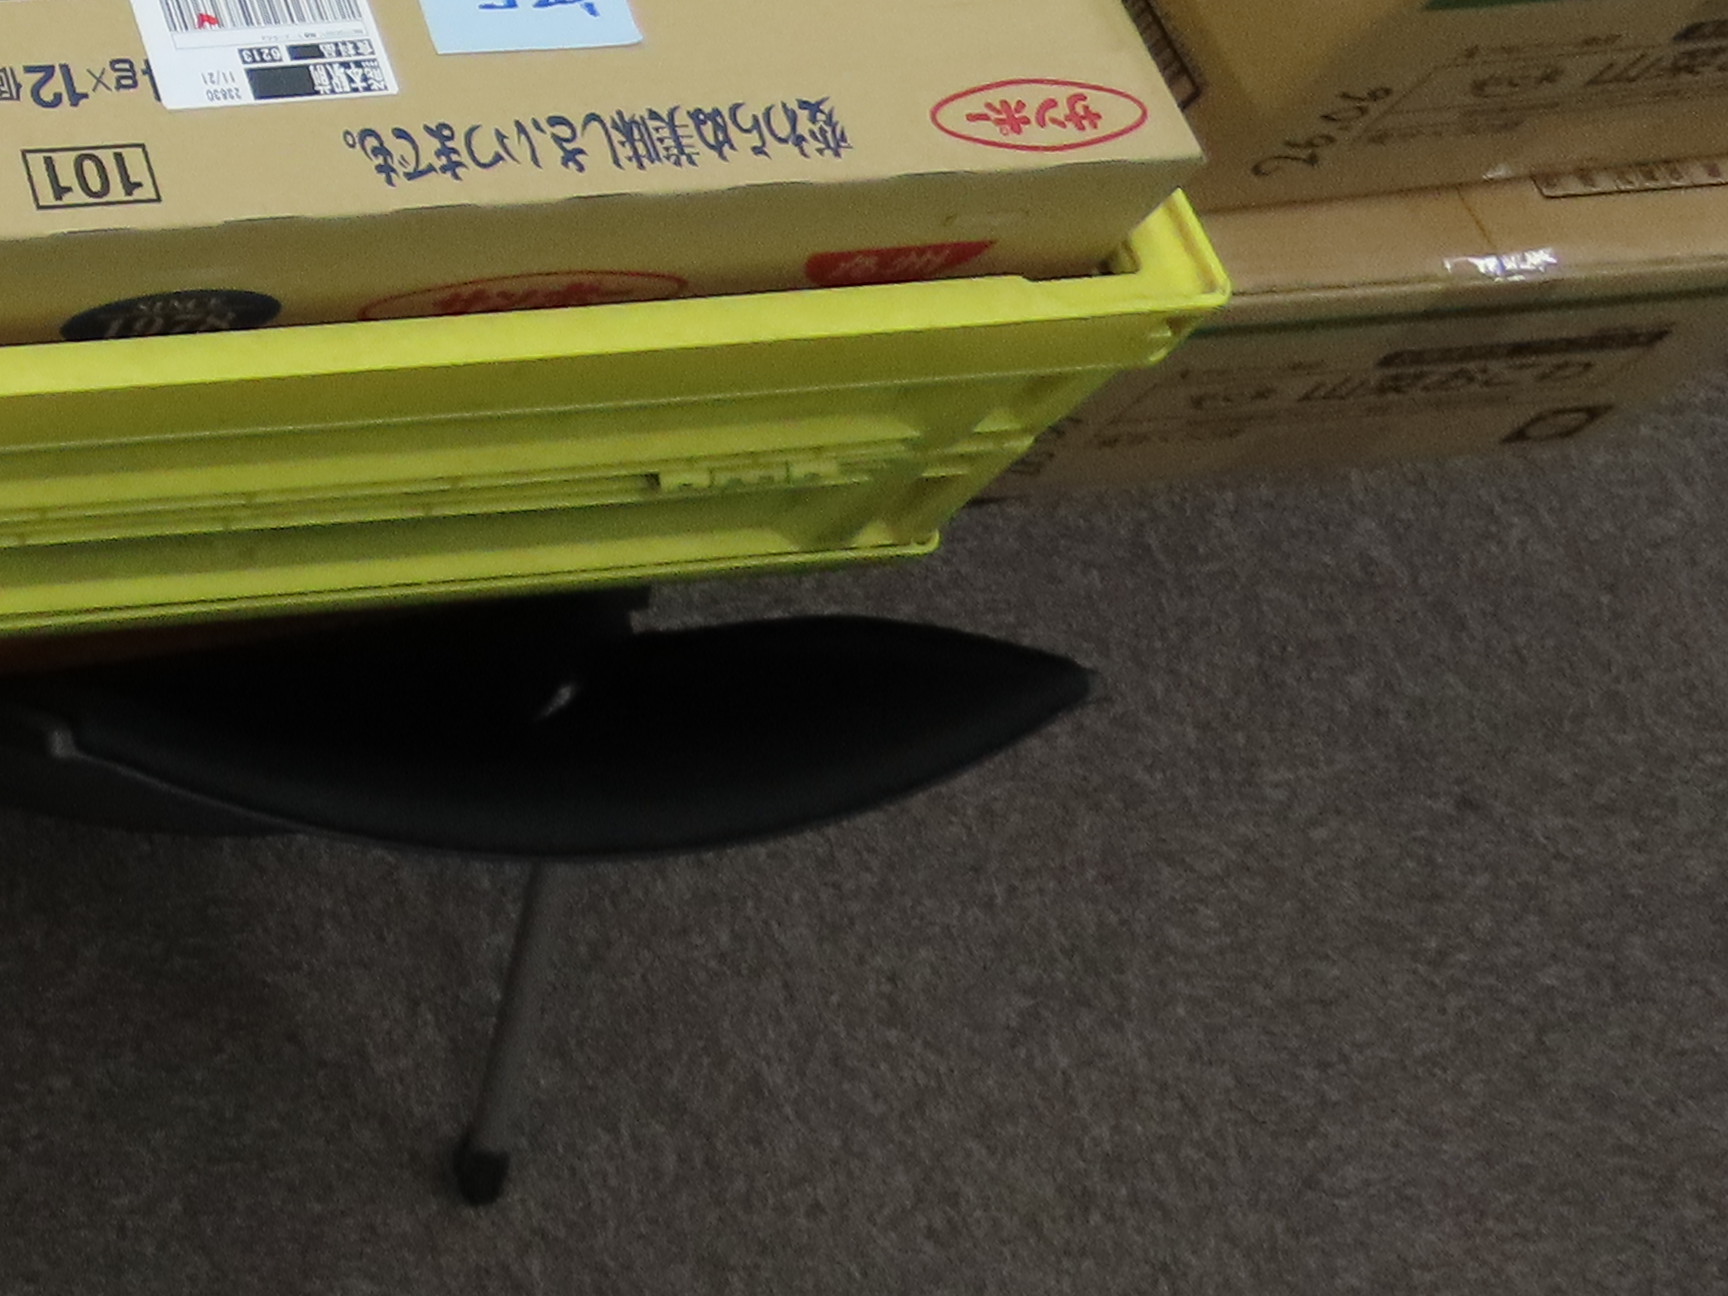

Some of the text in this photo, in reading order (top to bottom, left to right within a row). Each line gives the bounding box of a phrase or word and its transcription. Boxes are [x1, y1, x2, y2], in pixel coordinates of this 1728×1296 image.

[242, 41, 377, 64] 食料品 6213
[309, 60, 386, 96] 熊本駅前
[965, 93, 1105, 138] サンポー
[343, 95, 854, 187] 変わらぬ美味しさ、いつまでも。
[41, 150, 143, 204] 101
